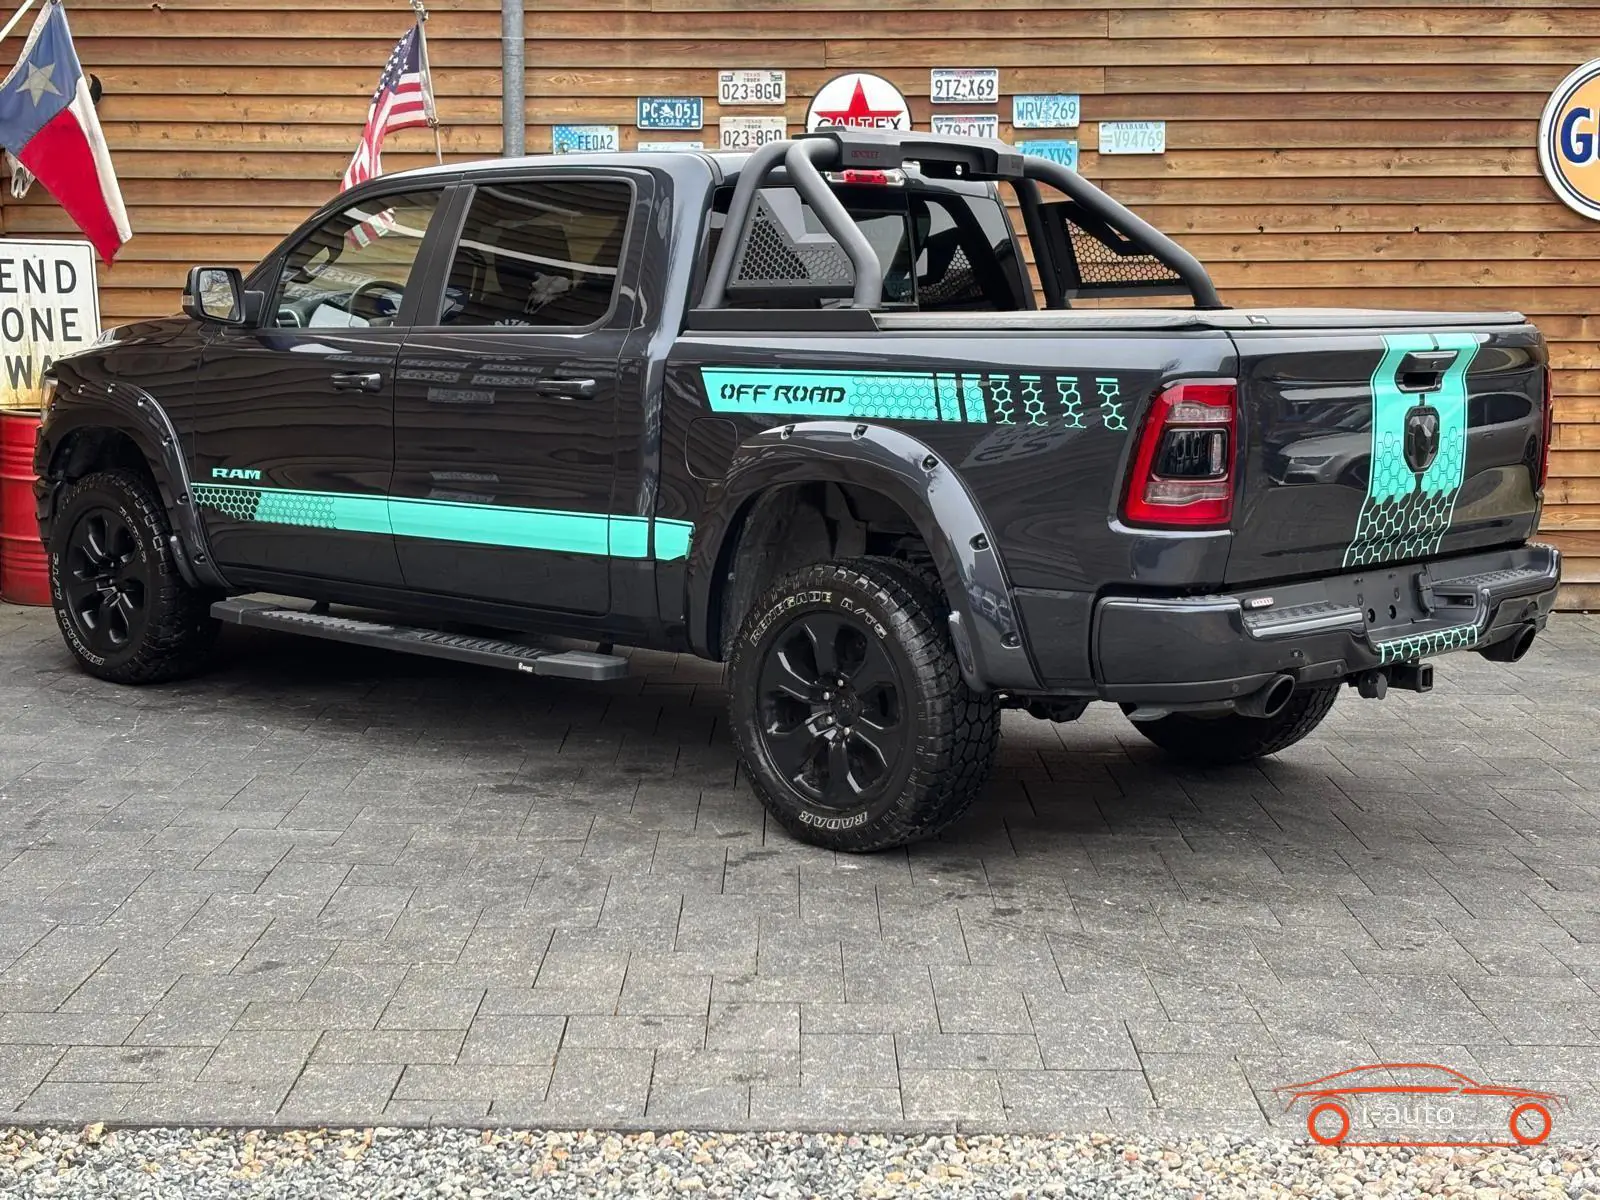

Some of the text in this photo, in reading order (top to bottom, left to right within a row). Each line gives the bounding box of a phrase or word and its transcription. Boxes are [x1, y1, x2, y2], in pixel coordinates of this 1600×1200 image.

[1560, 106, 1600, 164] G
[0, 258, 77, 294] END
[2, 307, 83, 343] ONE
[5, 354, 65, 390] WA
[720, 383, 846, 405] OFF ROAD
[212, 467, 261, 480] RAM
[749, 591, 833, 648] RENEGADE
[798, 810, 868, 830] RADAR
